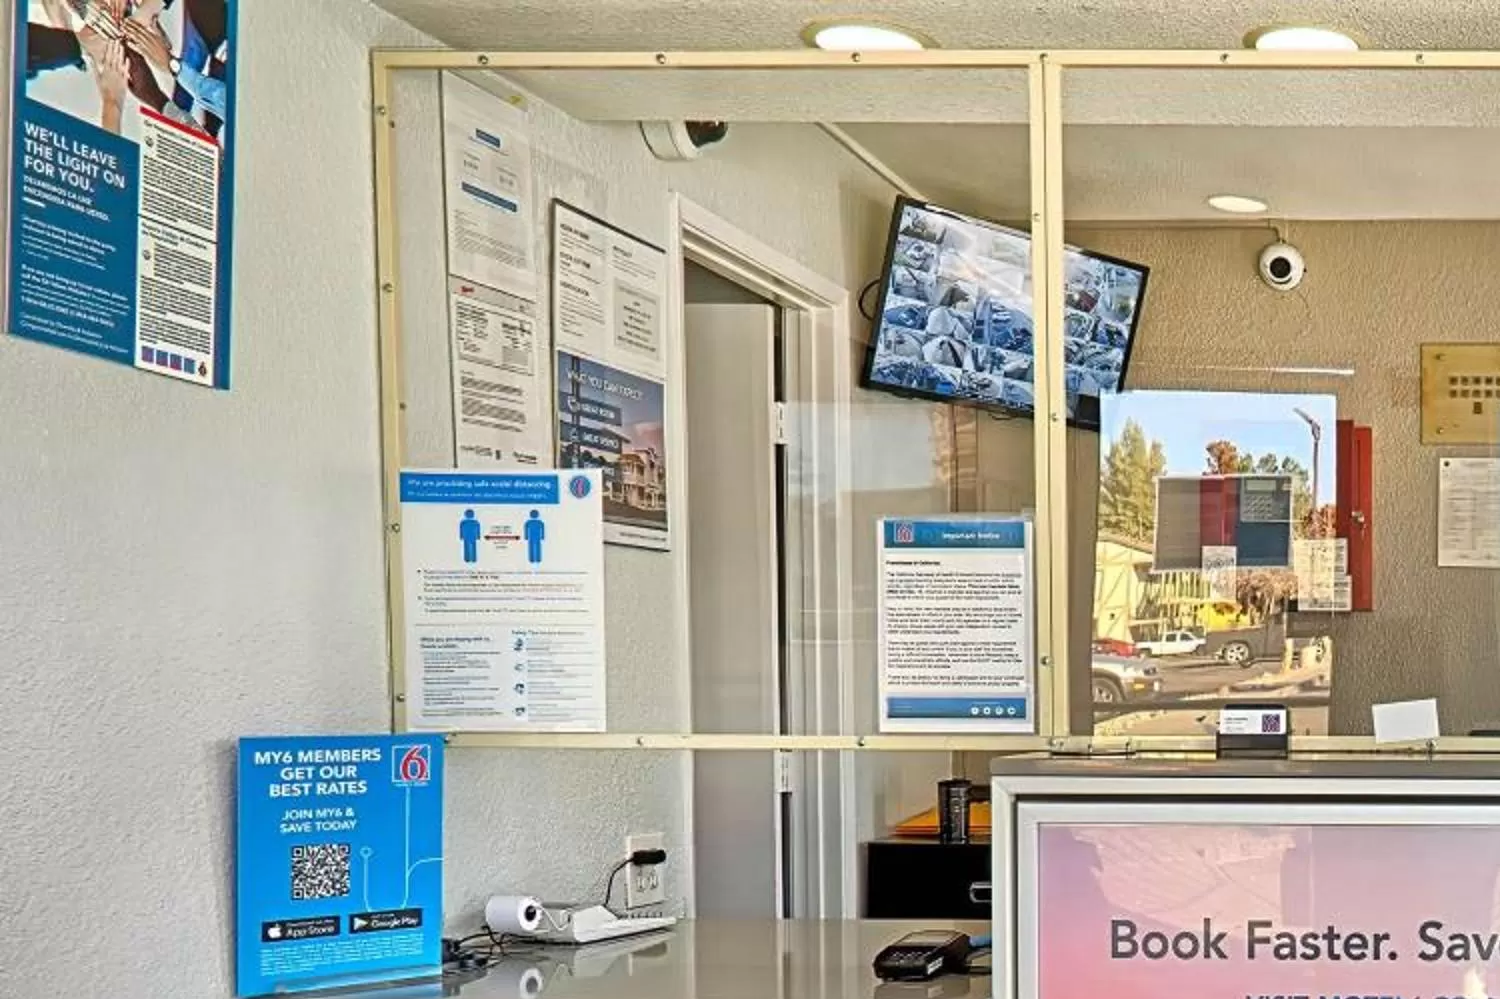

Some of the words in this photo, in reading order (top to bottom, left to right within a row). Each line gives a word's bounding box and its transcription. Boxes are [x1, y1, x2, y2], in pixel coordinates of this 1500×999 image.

[24, 121, 69, 151] WE'LL
[73, 140, 117, 169] LEAVE
[23, 138, 53, 161] THE
[57, 151, 99, 178] LIGHT
[103, 169, 125, 189] ON
[24, 155, 55, 178] FOR
[58, 167, 95, 193] YOU.
[254, 751, 293, 765] MY6
[297, 748, 382, 763] MEMBERS
[280, 766, 314, 781] GET
[319, 765, 357, 779] OUR
[269, 783, 312, 798] BEST
[316, 780, 368, 796] RATES
[282, 809, 313, 821] JOIN
[315, 808, 341, 819] MY6
[344, 807, 355, 817] &
[280, 821, 312, 834] SAVE
[315, 819, 357, 832] TODAY
[1110, 918, 1229, 960] Book
[1247, 919, 1398, 961] Faster.
